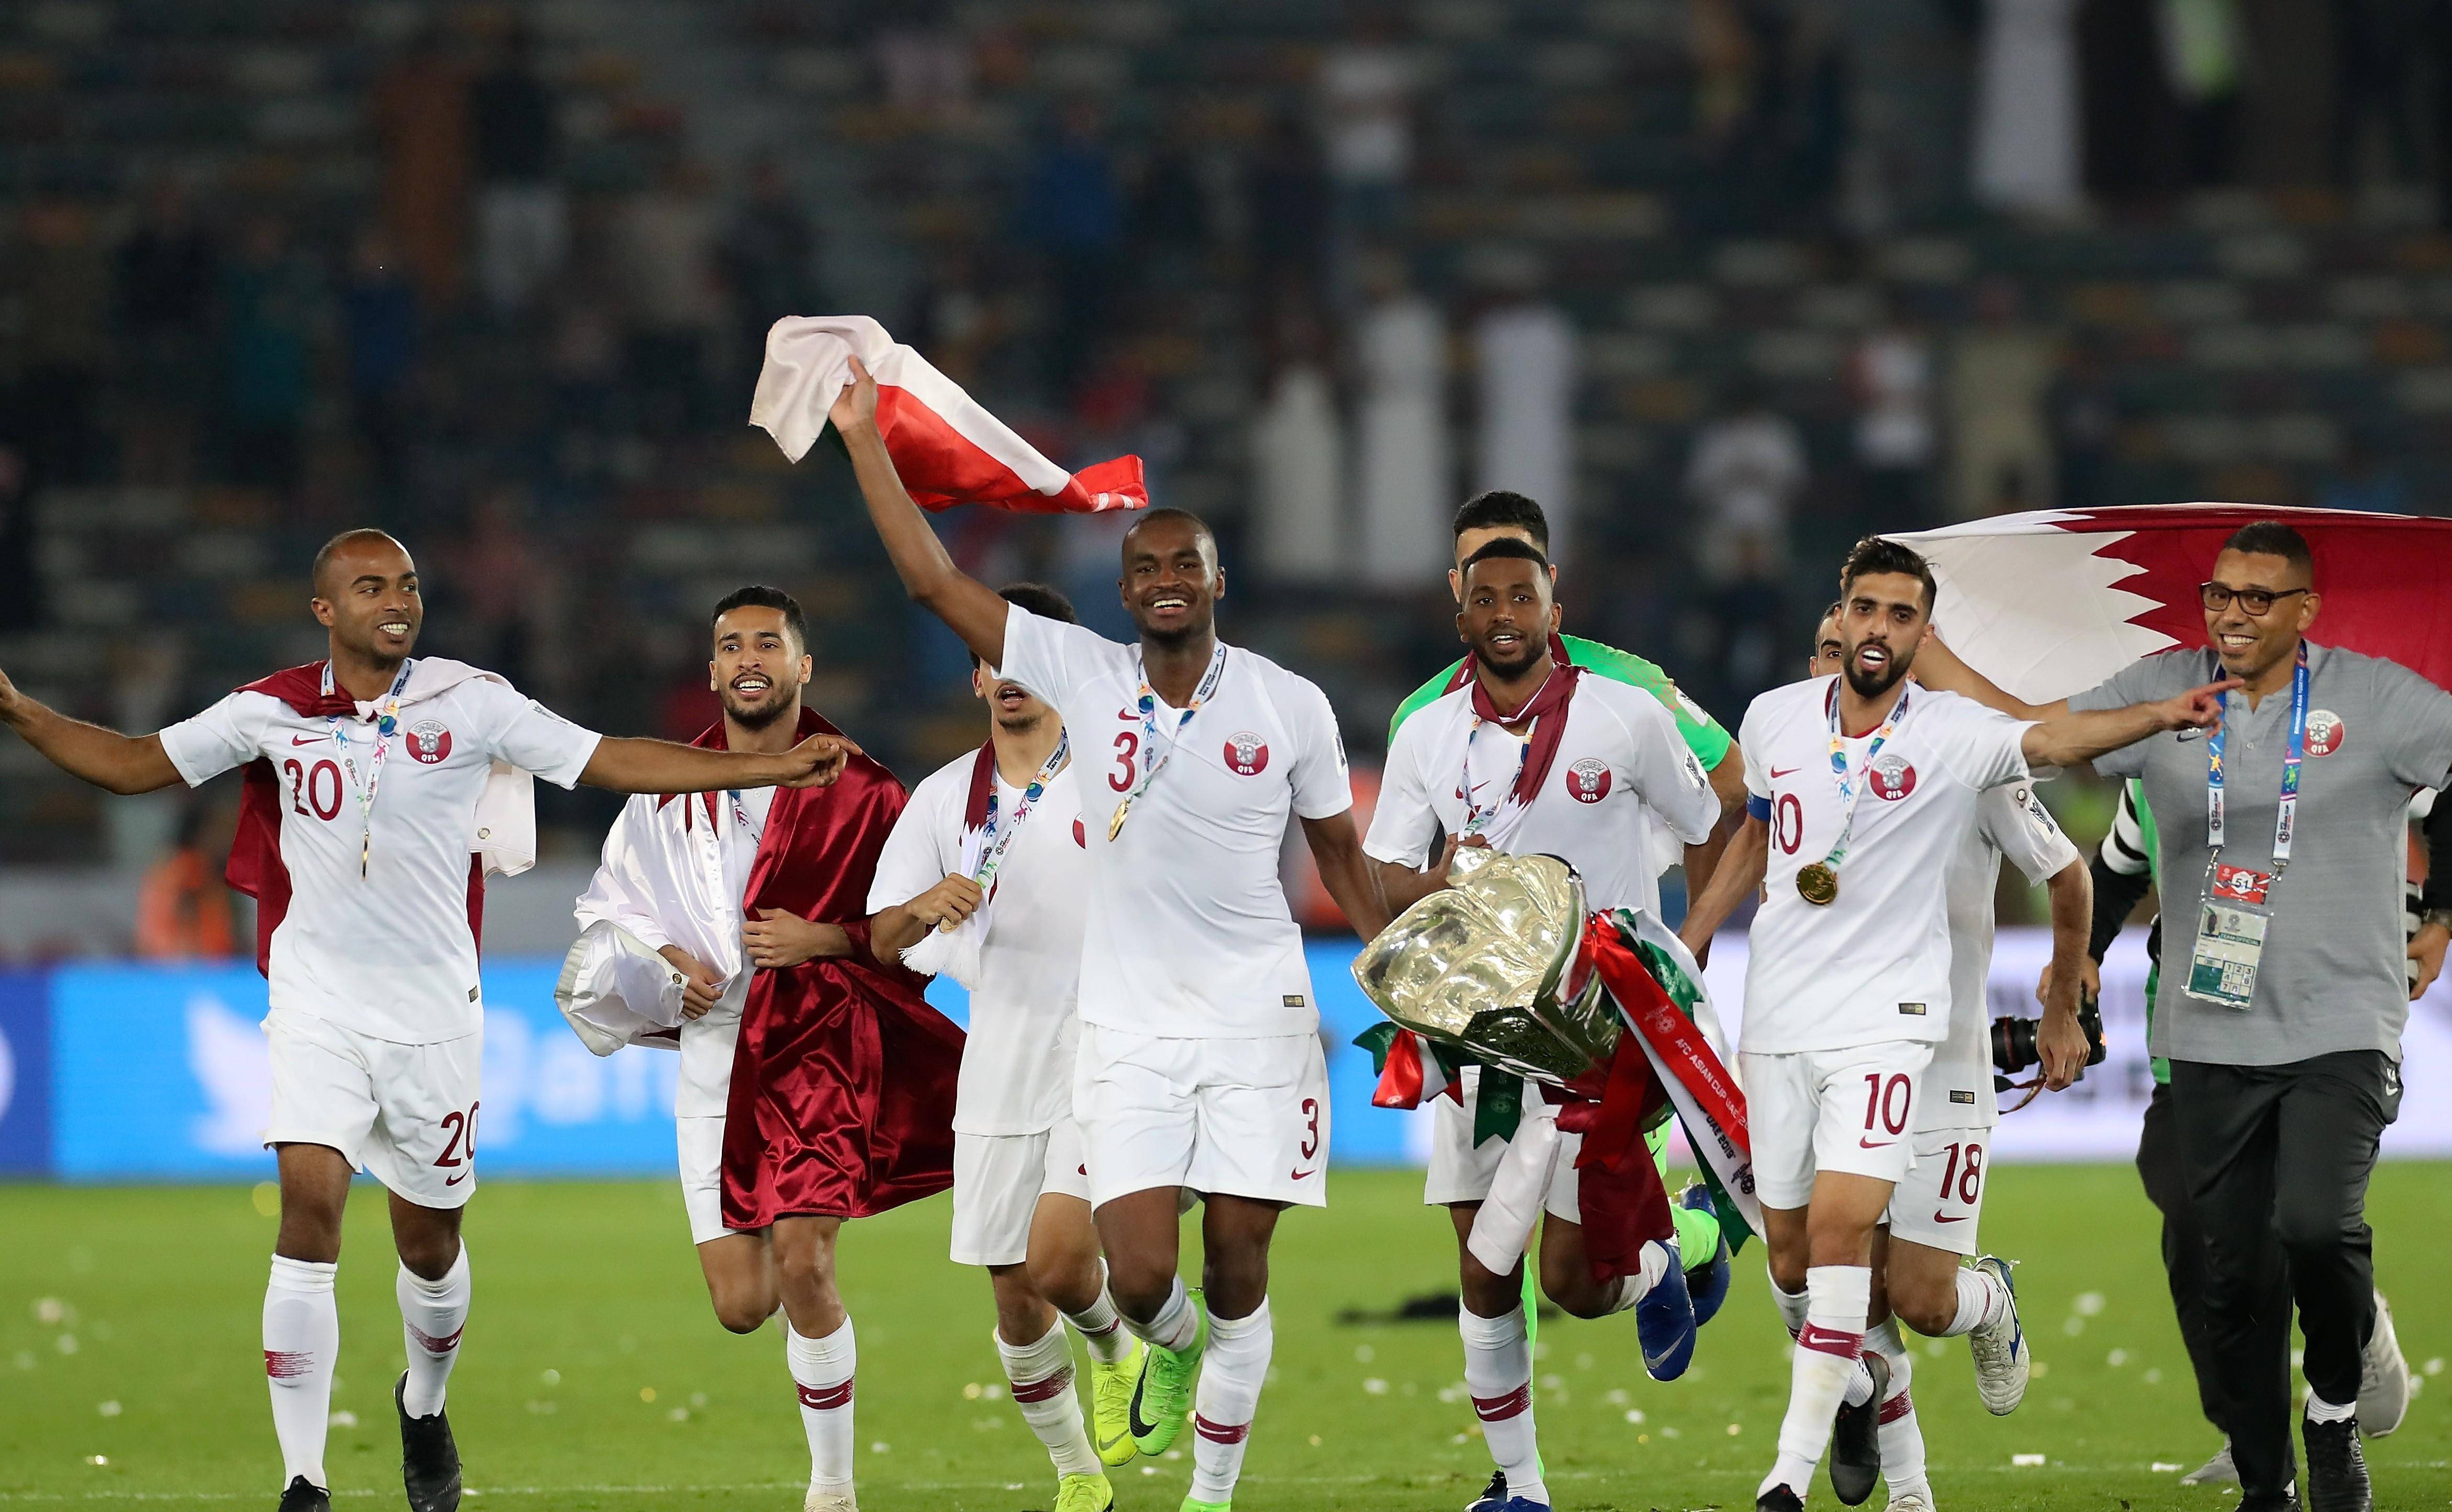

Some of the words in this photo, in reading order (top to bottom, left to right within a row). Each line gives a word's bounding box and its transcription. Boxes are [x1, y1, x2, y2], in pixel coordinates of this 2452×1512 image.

[1046, 750, 1060, 768] BRINGING
[1108, 732, 1138, 792] 3
[1238, 765, 1255, 774] QFA
[284, 758, 343, 821] 20
[1886, 790, 1904, 799] QFA
[2236, 878, 2248, 889] 51
[1675, 1039, 1692, 1055] AFC
[1689, 1054, 1713, 1083] ASIAN
[1711, 1079, 1727, 1098] CUP
[1726, 1098, 1739, 1119] UAE
[1738, 1116, 1749, 1130] 2
[1865, 1074, 1910, 1134] 10
[1301, 1098, 1318, 1160] 3
[1707, 1116, 1722, 1136] UAE
[1940, 1142, 1982, 1205] 18
